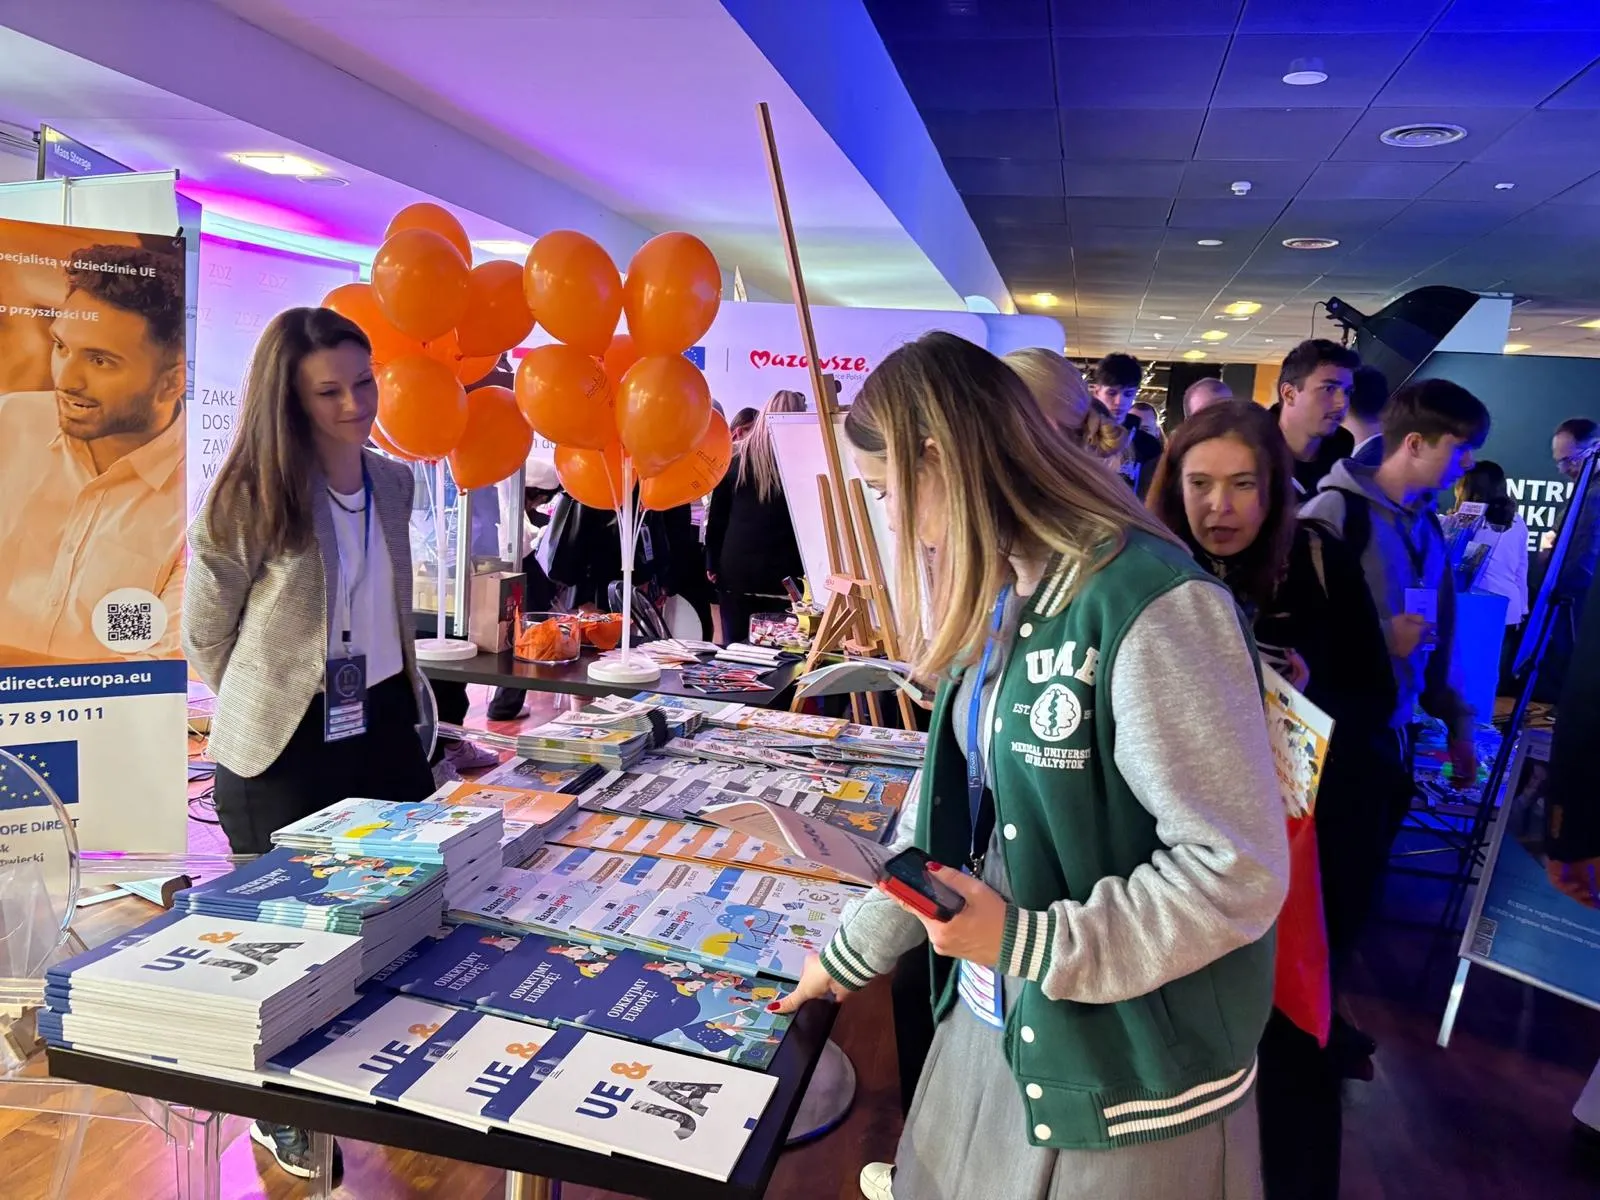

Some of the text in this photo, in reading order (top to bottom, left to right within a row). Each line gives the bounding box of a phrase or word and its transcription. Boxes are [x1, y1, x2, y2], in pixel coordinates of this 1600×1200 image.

[60, 260, 71, 268] w
[74, 260, 138, 276] dziedzinie
[140, 267, 156, 278] UE
[10, 305, 80, 320] przyszłości
[82, 311, 99, 322] UE
[0, 672, 152, 692] direct.europa.eu
[9, 707, 104, 726] 7 8 9 10 11
[32, 818, 80, 832] DIRET
[140, 946, 213, 972] UE
[198, 942, 306, 982] JA
[434, 951, 482, 987] ODKRYJMY
[509, 960, 553, 1000] ODKRYJMY
[524, 972, 562, 1004] EUROPĘ!
[606, 978, 649, 1018] ODKRYJMY
[621, 989, 660, 1022] EUROPĘ!
[574, 1062, 653, 1120] UE &
[630, 1080, 724, 1141] JA
